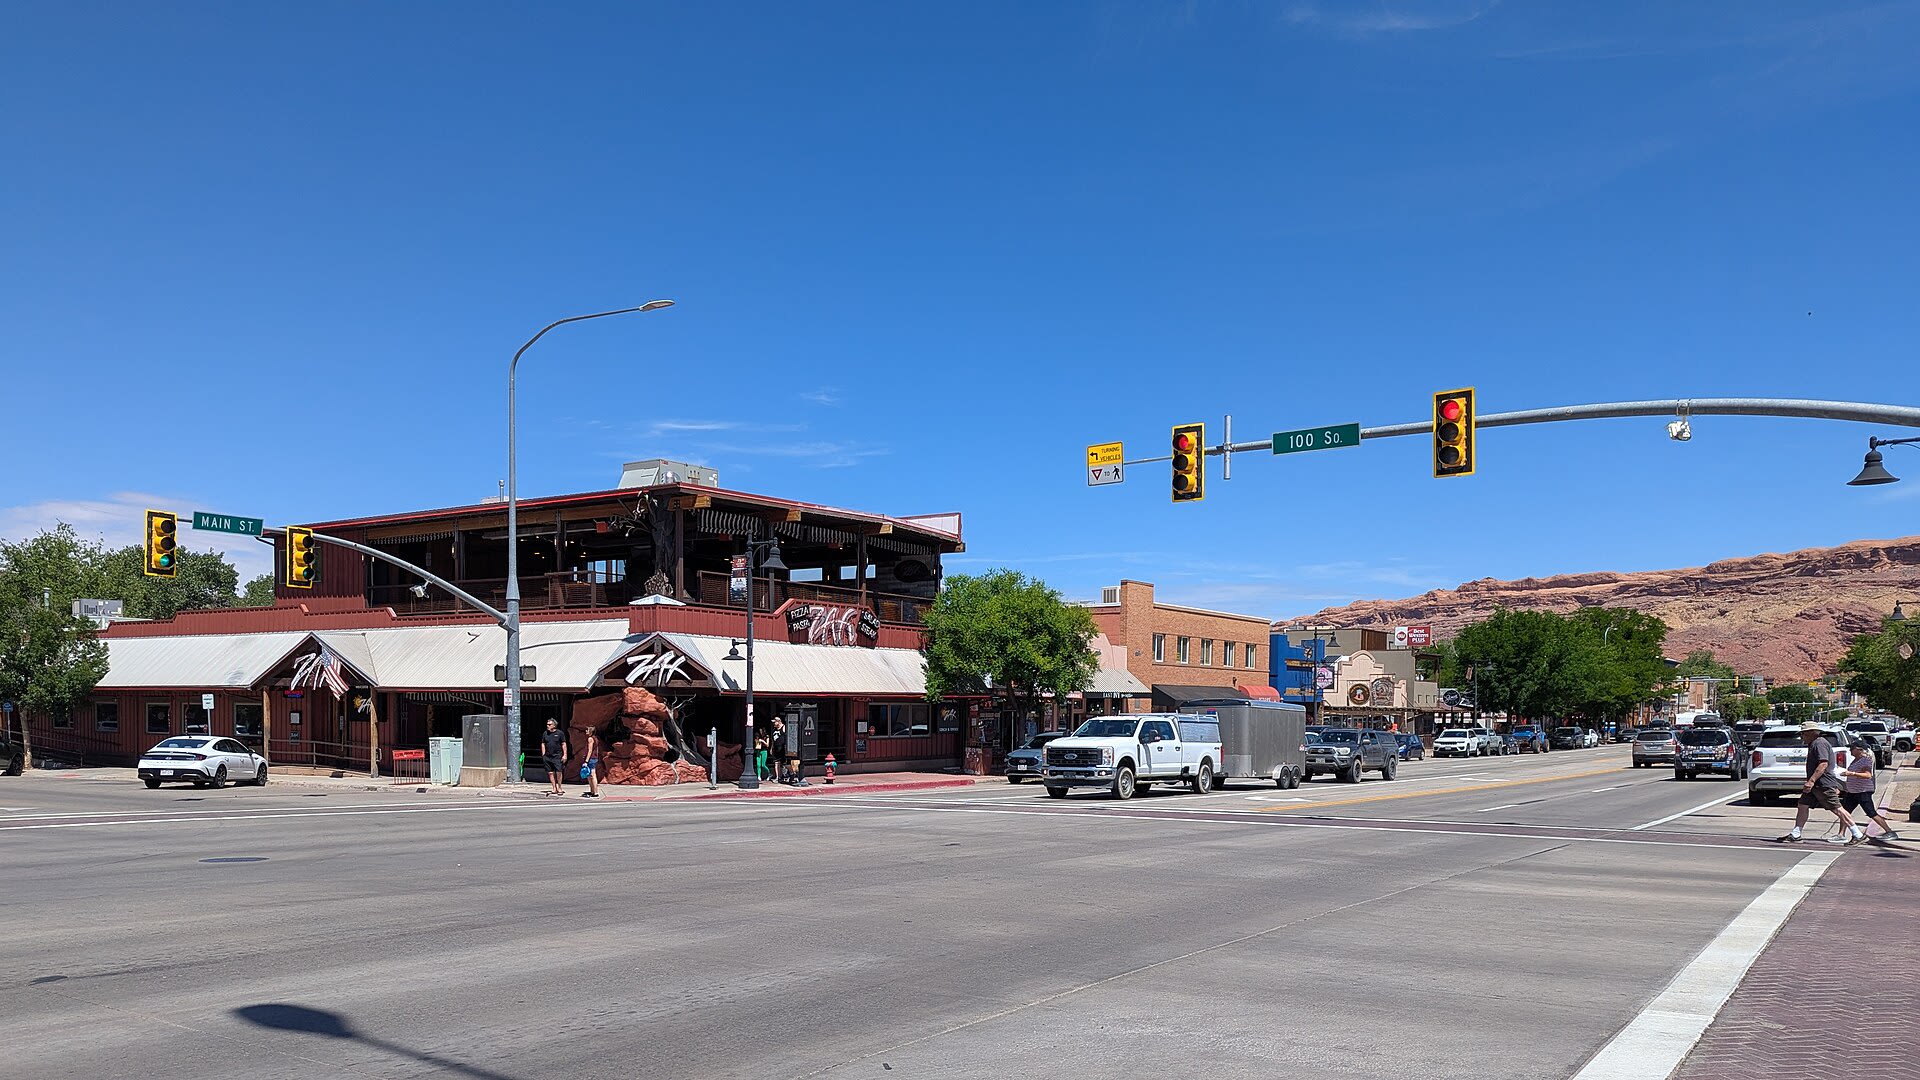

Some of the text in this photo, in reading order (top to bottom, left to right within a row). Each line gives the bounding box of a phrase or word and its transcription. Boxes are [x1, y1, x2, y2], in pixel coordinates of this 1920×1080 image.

[1289, 430, 1343, 449] 100 So.
[1101, 446, 1120, 454] TURNING
[1099, 454, 1121, 462] VEHICLES
[201, 516, 255, 532] MAIN ST.
[790, 606, 809, 620] PIZZA
[792, 619, 810, 632] PASTA
